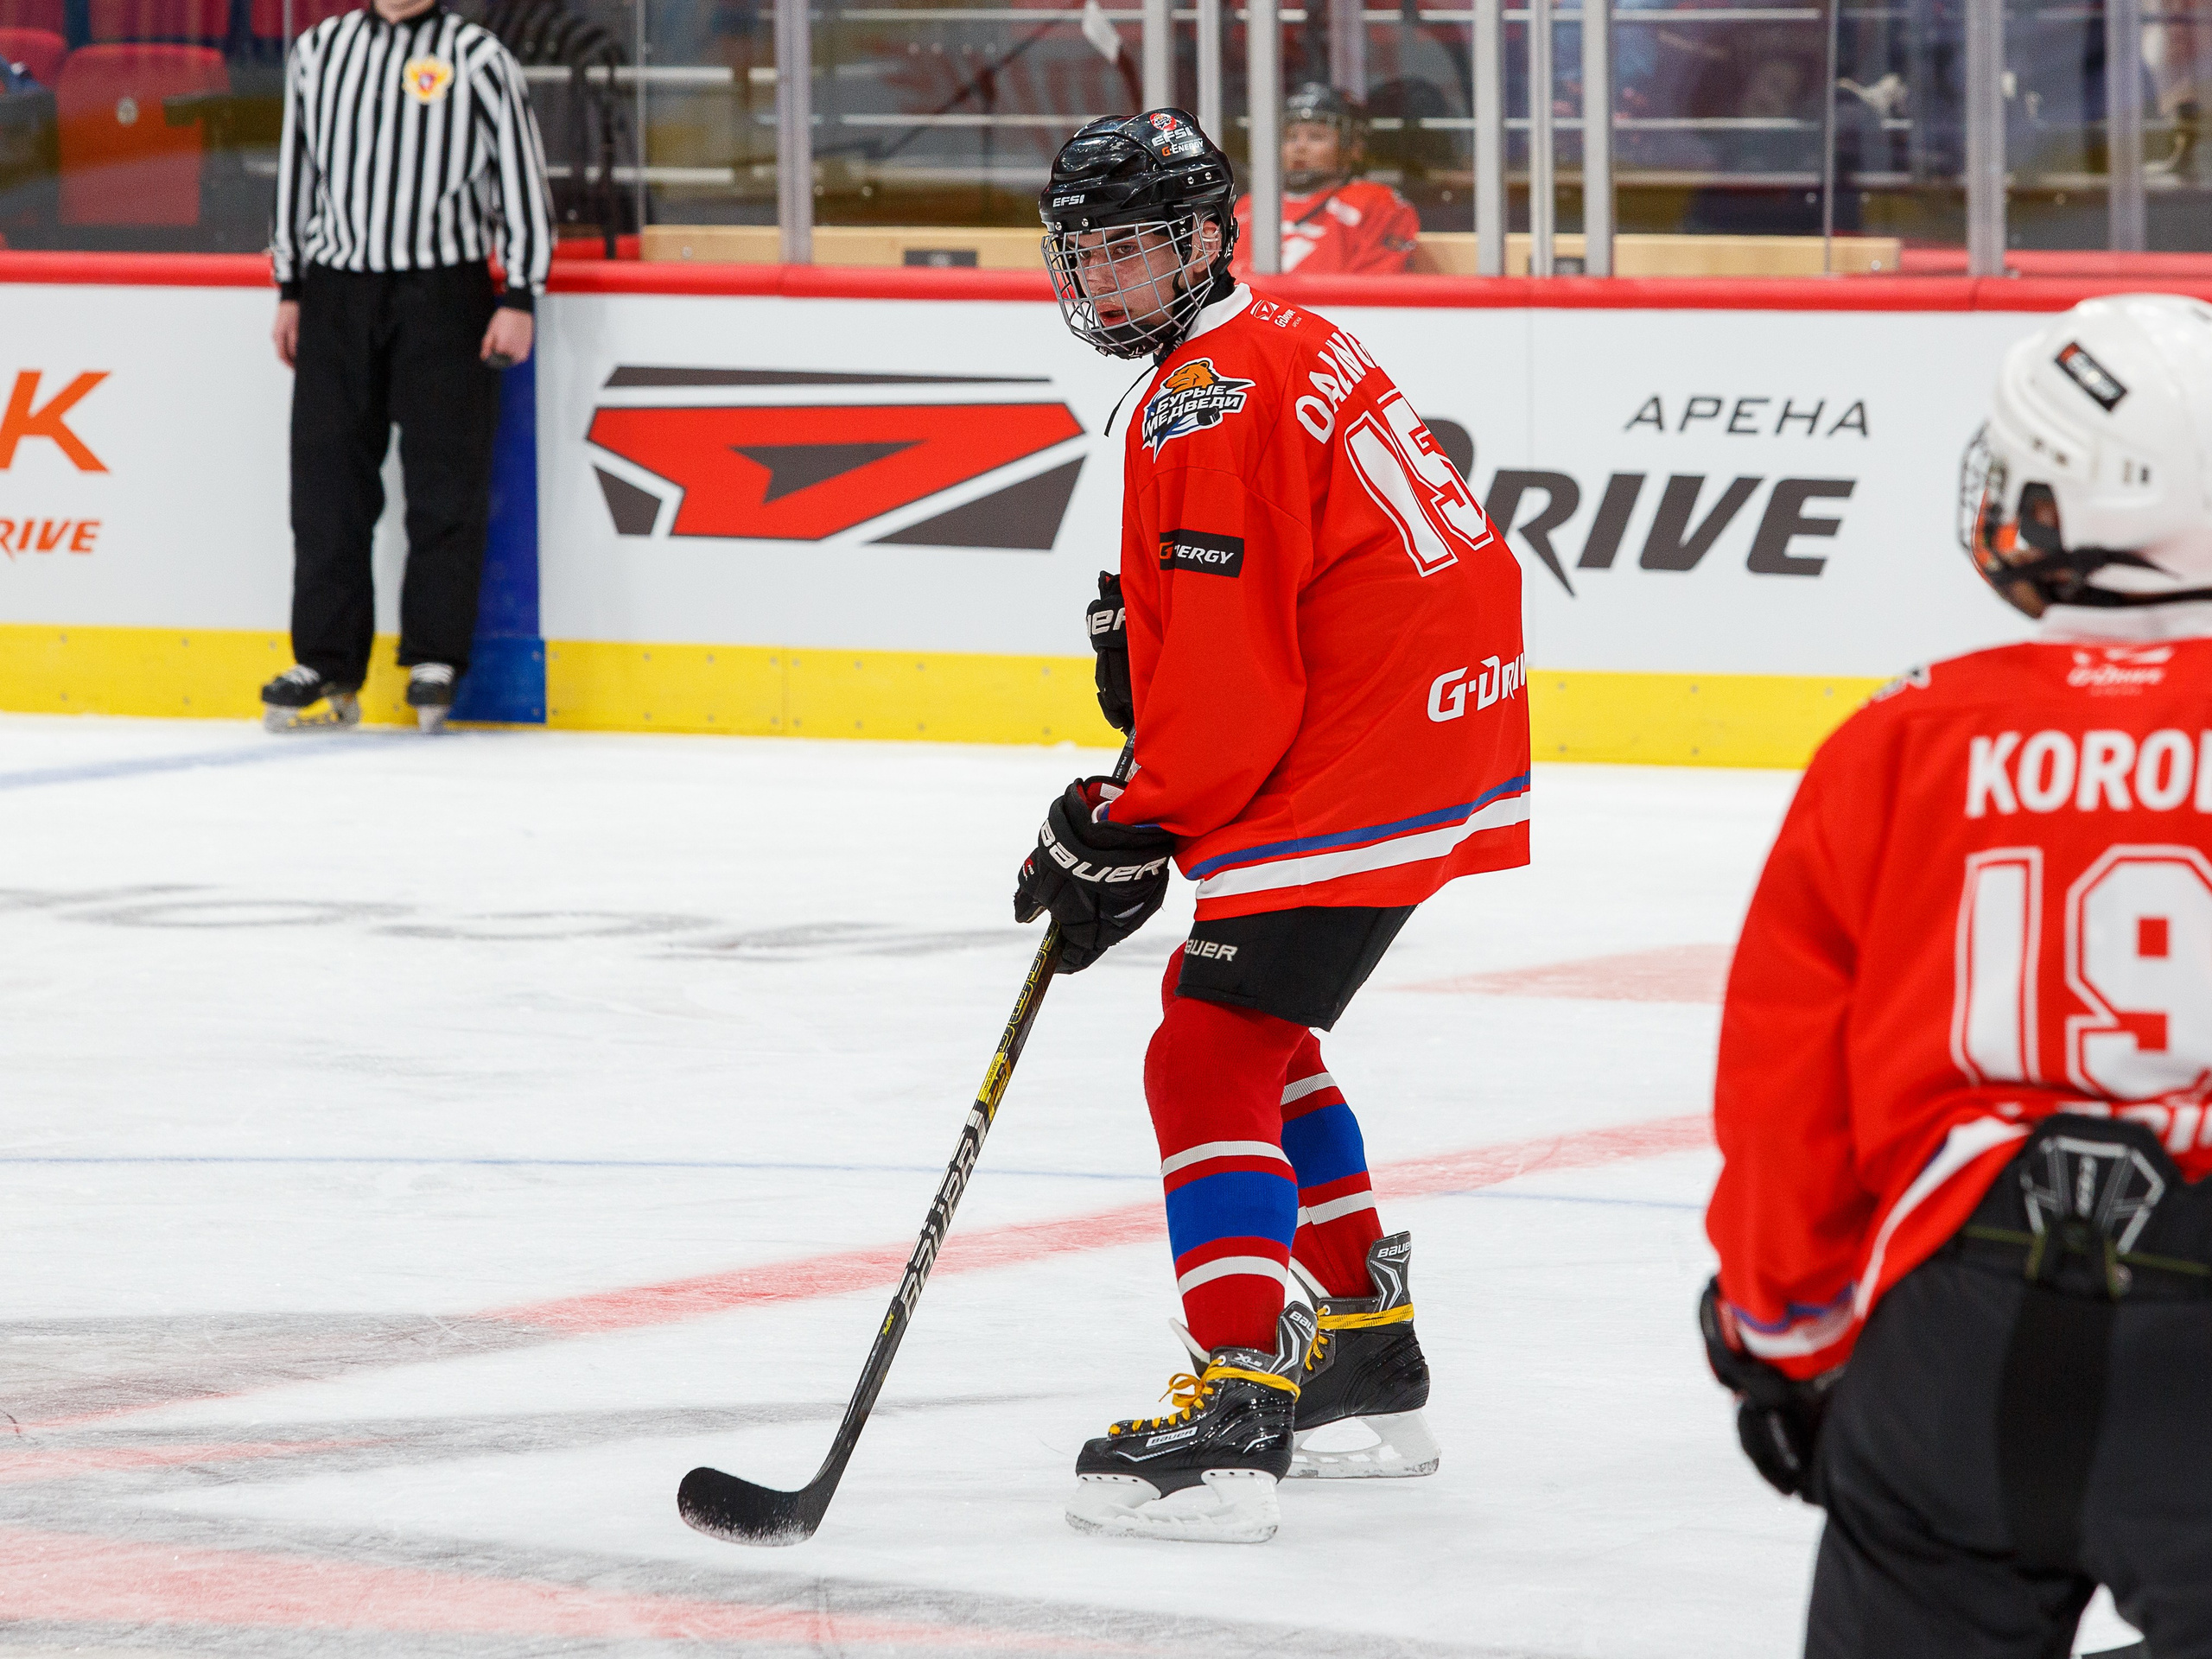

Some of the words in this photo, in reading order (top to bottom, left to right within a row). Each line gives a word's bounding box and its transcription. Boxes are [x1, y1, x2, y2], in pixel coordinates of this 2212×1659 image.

[1052, 194, 1085, 207] EFSI
[1146, 397, 1240, 438] МЕДВЕДИ
[1156, 385, 1226, 414] БУРЫЕ
[1624, 394, 1871, 438] АРЕНА
[1344, 387, 1493, 577] 15
[1421, 416, 1858, 598] RIVE
[1040, 820, 1166, 883] BAUER
[1951, 844, 2212, 1103] 19
